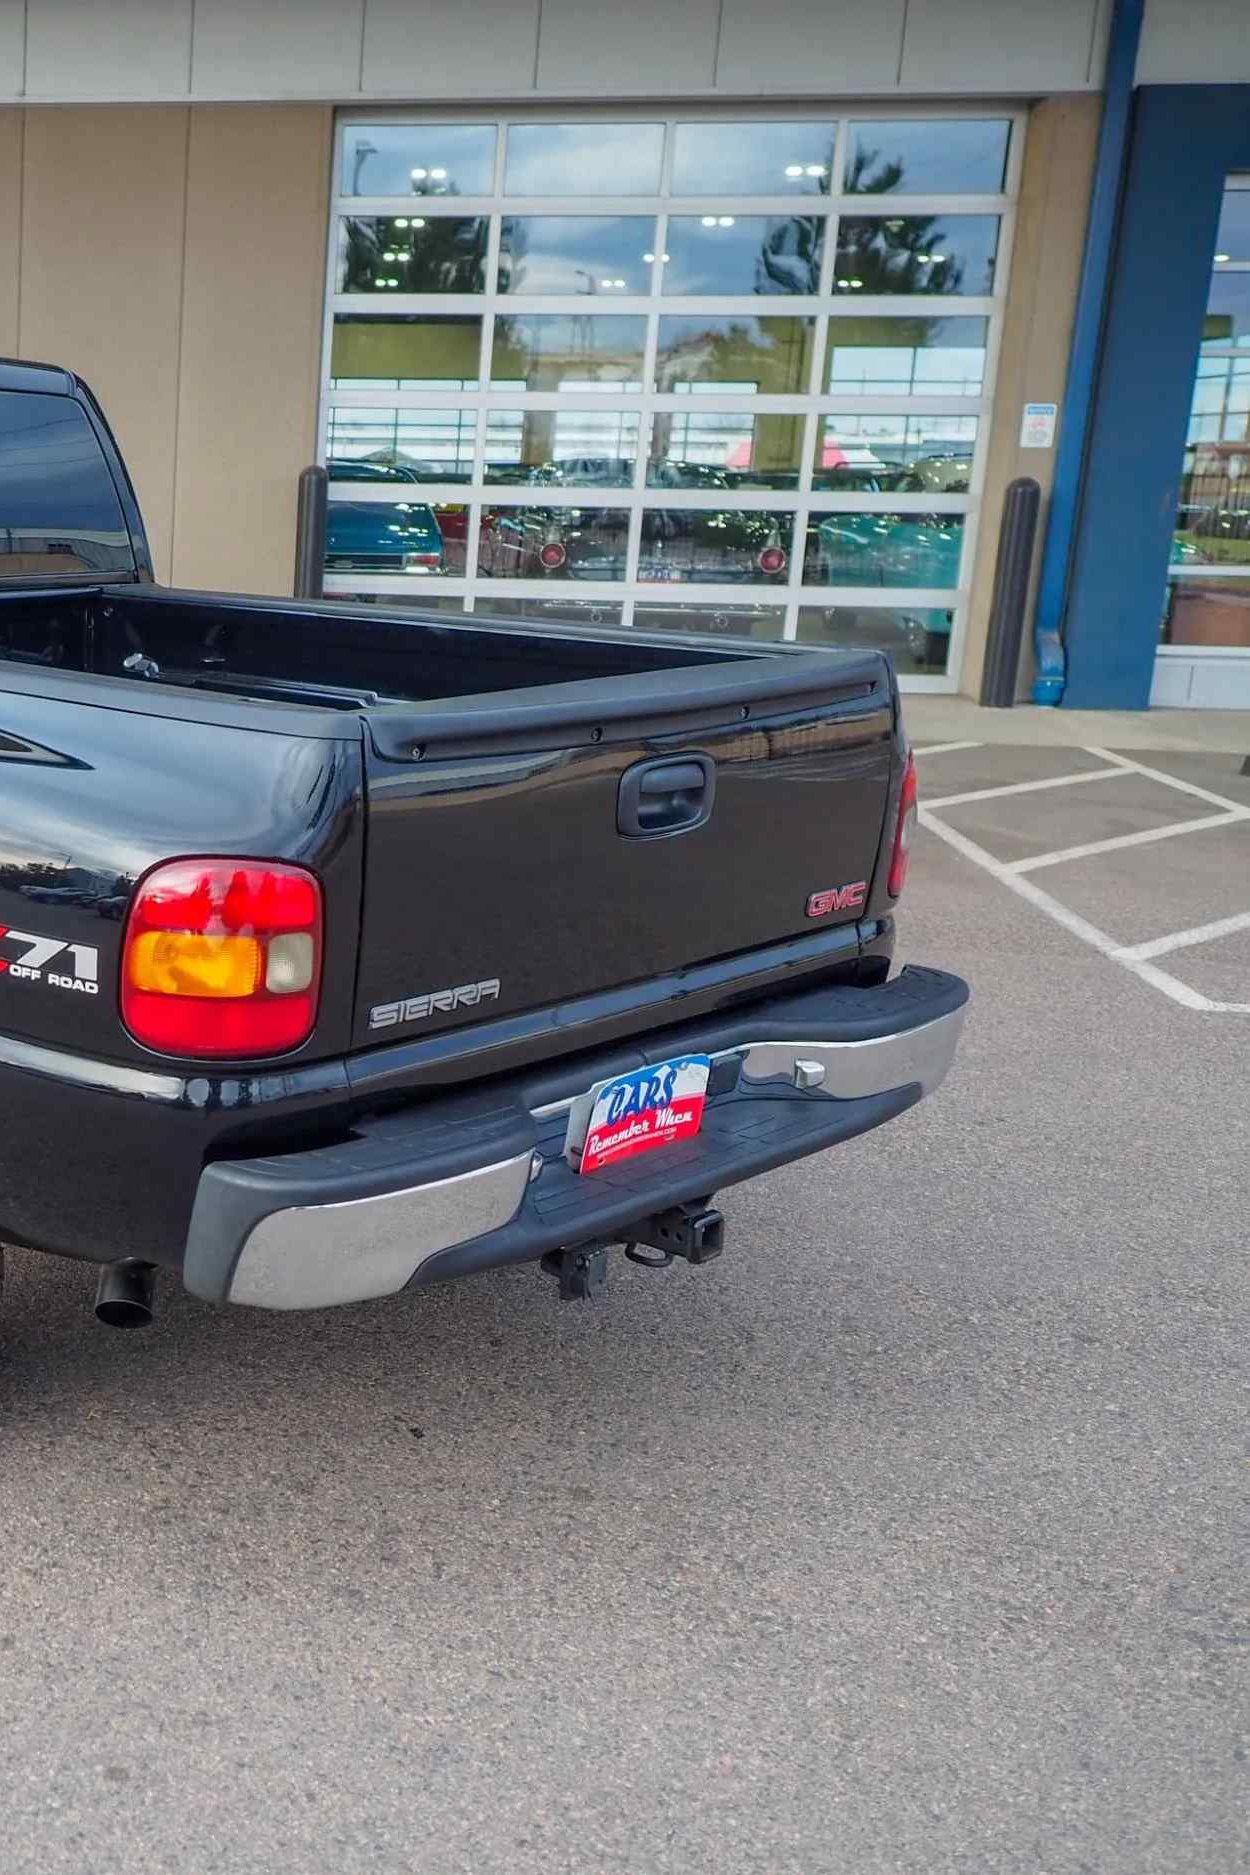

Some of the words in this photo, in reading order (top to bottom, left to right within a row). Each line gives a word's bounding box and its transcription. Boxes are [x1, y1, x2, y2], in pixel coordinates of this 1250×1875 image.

[806, 881, 866, 917] GMC
[9, 964, 41, 980] OFF
[48, 973, 99, 994] ROAD
[370, 978, 500, 1029] SIERRA
[608, 1069, 677, 1124] CARS
[588, 1120, 650, 1156] Remember
[656, 1108, 693, 1128] When
